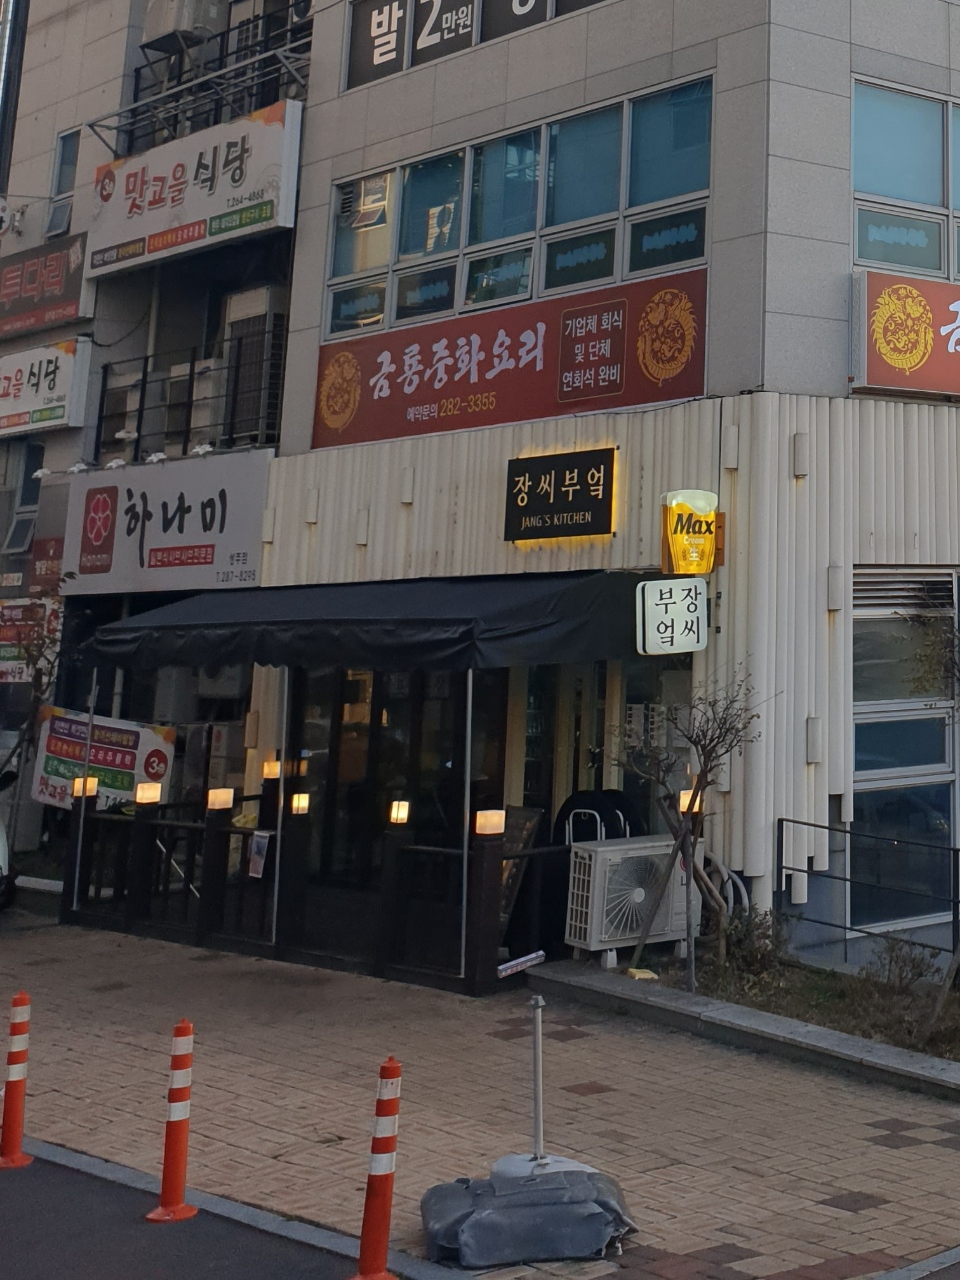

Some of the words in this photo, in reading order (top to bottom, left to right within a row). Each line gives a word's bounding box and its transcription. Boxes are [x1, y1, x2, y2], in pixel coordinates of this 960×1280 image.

[370, 1, 404, 65] 발
[0, 250, 68, 311] 투다리
[564, 317, 597, 339] 기업체
[600, 311, 623, 331] 회식
[574, 343, 586, 363] 및
[588, 339, 611, 360] 단체
[562, 369, 596, 391] 연회석
[597, 364, 621, 387] 완비
[406, 403, 438, 423] 예약문의
[439, 392, 497, 418] 282-3355
[513, 464, 605, 507] 장씨부엌
[124, 488, 228, 569] 하나미
[553, 511, 592, 526] KITCHEN
[672, 513, 715, 535] Max
[683, 535, 705, 545] Cream
[689, 546, 700, 561] 生
